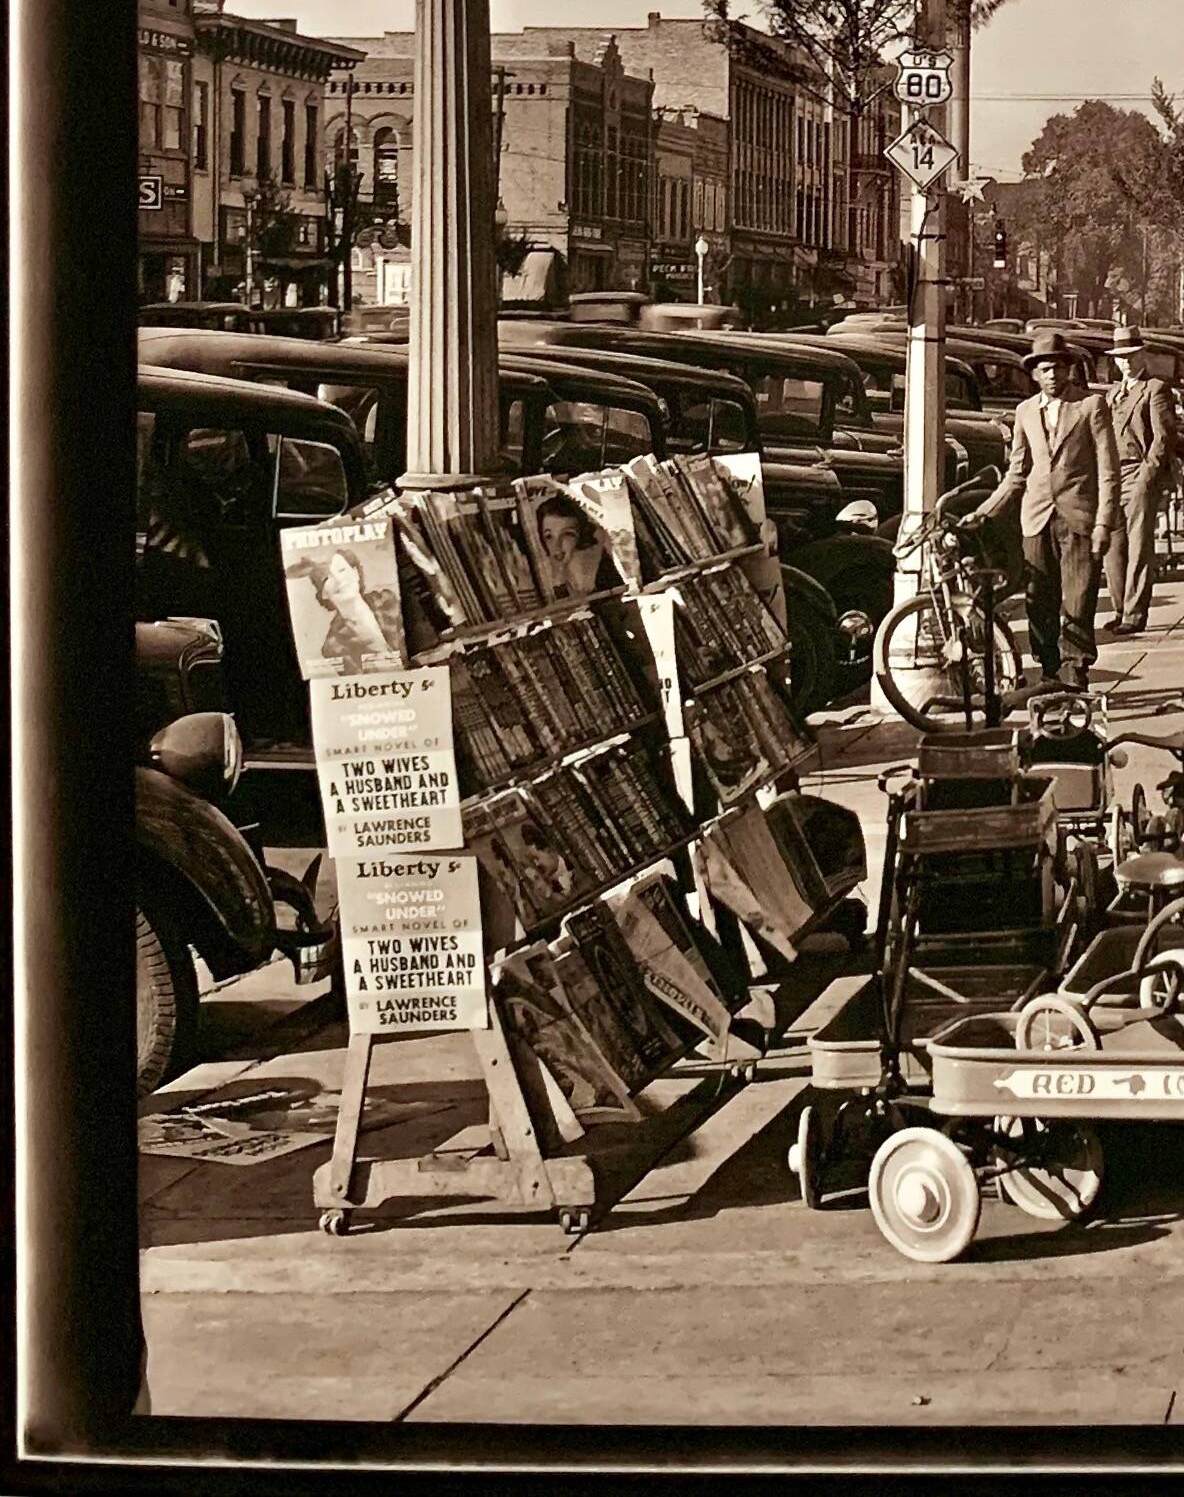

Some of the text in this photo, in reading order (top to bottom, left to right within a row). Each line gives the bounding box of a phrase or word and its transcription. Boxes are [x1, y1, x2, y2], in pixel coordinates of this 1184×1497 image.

[907, 73, 942, 99] 80
[912, 145, 935, 171] 14
[331, 680, 414, 700] Liberty
[374, 741, 417, 752] NOVEL
[423, 737, 440, 749] OF
[342, 755, 430, 778] TWO WIVES
[330, 772, 449, 797] A HUSBAND AND
[336, 789, 447, 814] A SWEETHEART
[354, 816, 431, 834] LAWRENCE
[357, 830, 431, 848] SAUNDERS
[357, 860, 441, 879] Liberty
[352, 919, 468, 934] SMART NOVEL OF
[368, 935, 459, 956] TWO WIVES
[353, 953, 476, 974] A HUSBAND AND
[358, 970, 473, 991] A SWEETHEART
[376, 995, 457, 1013] LAWRENCE
[379, 1009, 458, 1025] SAUNDERS
[1031, 1072, 1096, 1096] RED
